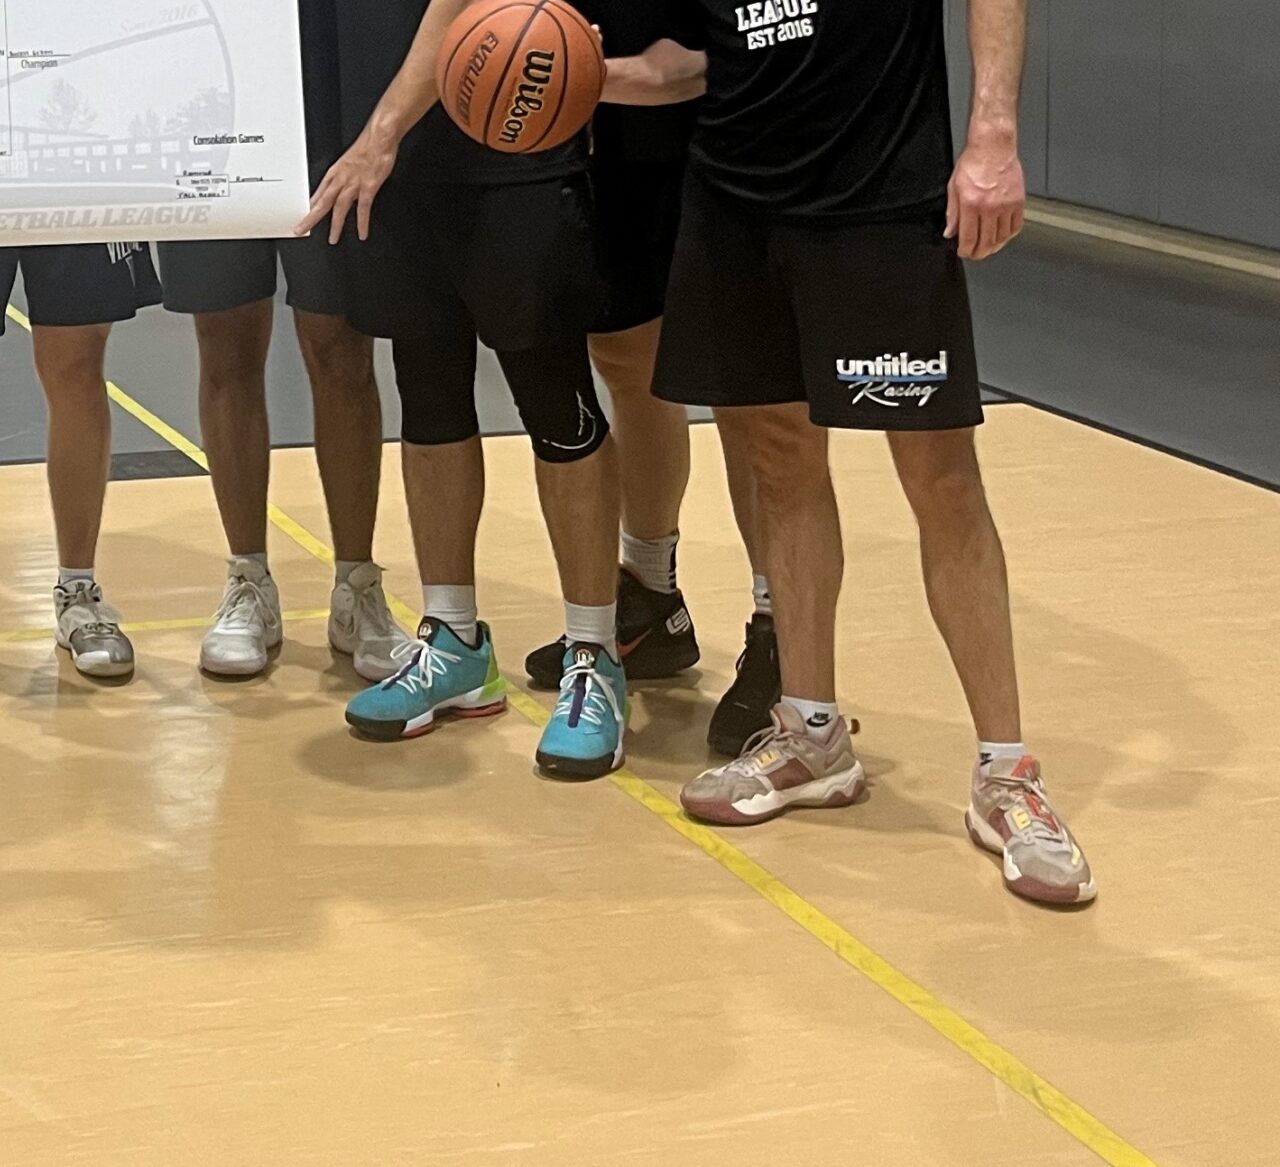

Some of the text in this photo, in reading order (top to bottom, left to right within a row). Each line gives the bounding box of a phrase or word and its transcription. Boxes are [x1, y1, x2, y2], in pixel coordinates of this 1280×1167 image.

[777, 17, 815, 42] 2016
[21, 58, 59, 70] Champion
[497, 48, 556, 144] Wilson
[192, 133, 265, 145] Consolation Games
[101, 204, 212, 228] LEAGUE
[835, 350, 948, 377] untitled
[847, 377, 939, 407] Racing
